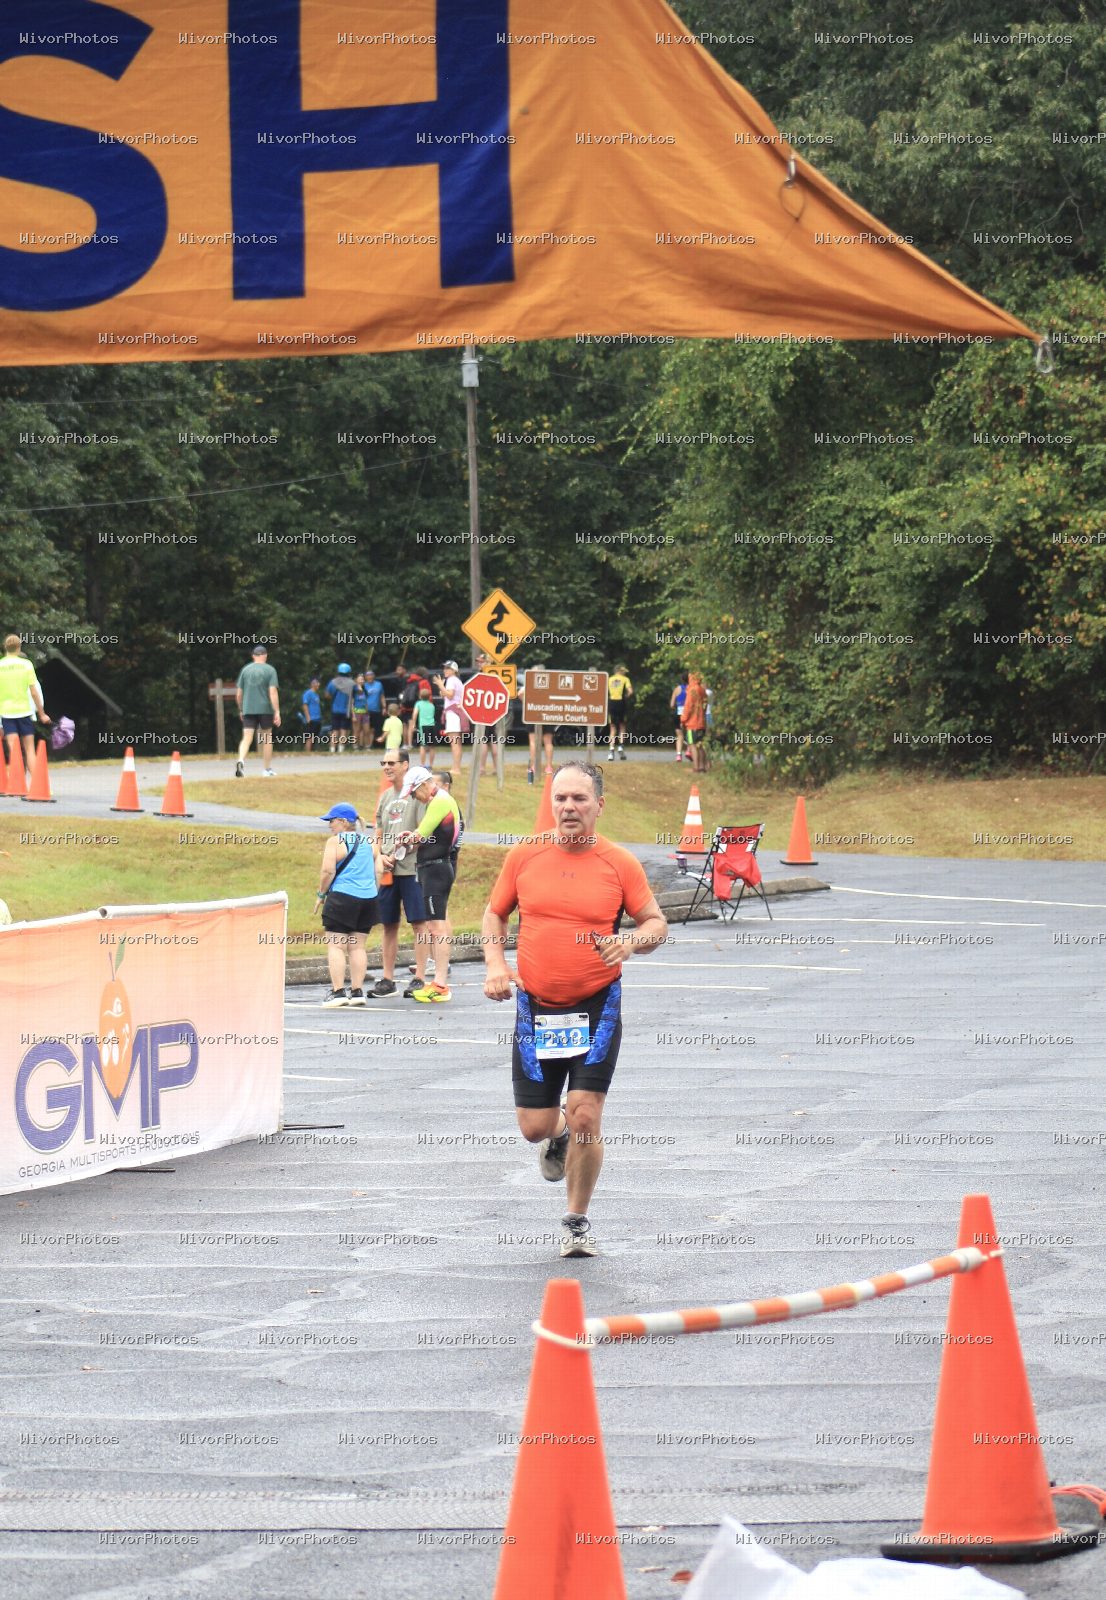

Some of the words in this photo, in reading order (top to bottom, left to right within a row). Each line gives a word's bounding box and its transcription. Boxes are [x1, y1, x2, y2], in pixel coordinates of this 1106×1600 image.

[464, 687, 506, 711] STOP
[527, 703, 563, 712] Muscadine
[564, 704, 588, 713] Nature
[588, 705, 604, 713] Trail
[542, 713, 564, 721] Tennis
[564, 714, 588, 723] Courts
[15, 1018, 200, 1154] GMP
[18, 1162, 66, 1178] GEORGIA
[70, 1144, 137, 1168] MULTISPORTS
